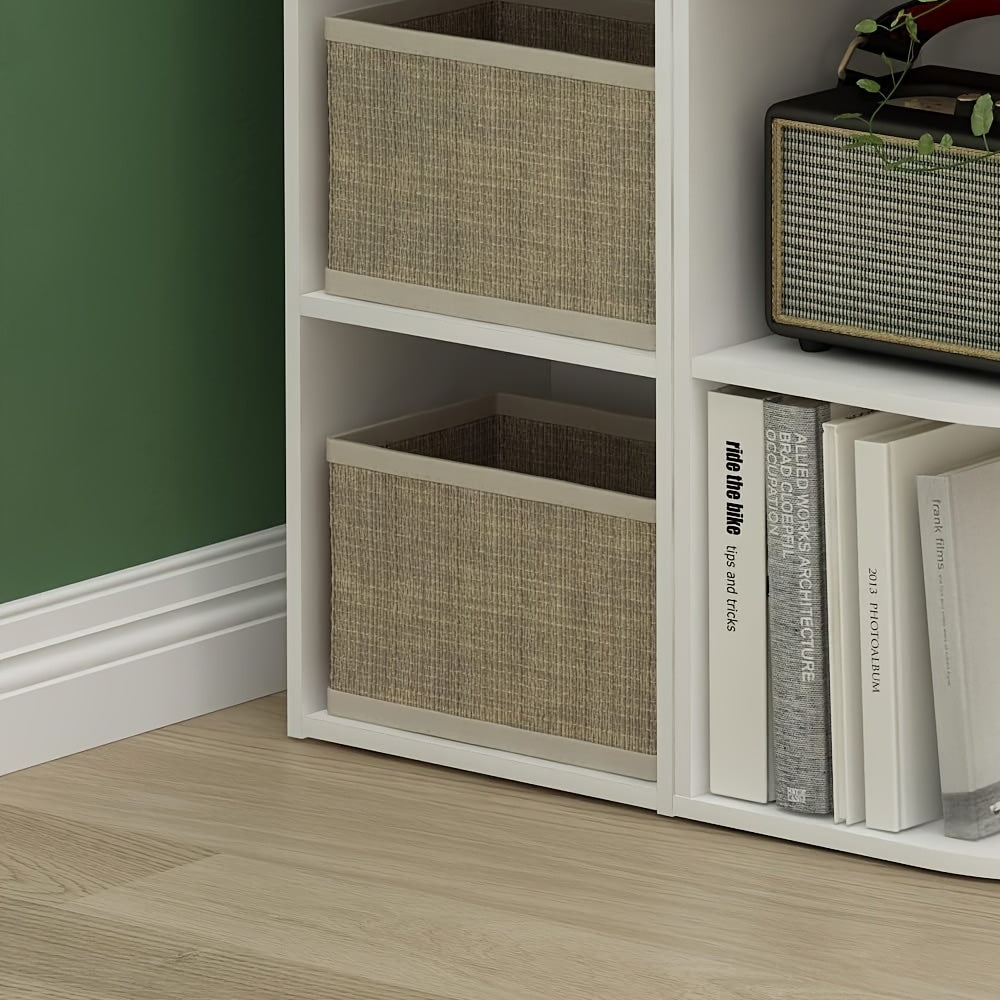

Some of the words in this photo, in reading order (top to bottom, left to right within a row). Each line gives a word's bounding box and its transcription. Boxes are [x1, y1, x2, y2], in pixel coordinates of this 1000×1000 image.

[725, 441, 743, 472] ride
[779, 431, 792, 480] BRAD
[795, 432, 809, 490] ALLIED
[726, 474, 743, 500] the
[766, 429, 779, 539] OCCUPATION
[726, 502, 744, 536] bike
[797, 495, 811, 552] WORKS
[932, 499, 943, 533] frank
[724, 545, 737, 568] tips
[936, 537, 945, 570] films
[726, 571, 738, 595] and
[868, 567, 878, 594] 2013
[726, 598, 740, 632] tricks
[798, 555, 815, 682] ARCHITECTURE
[869, 602, 880, 693] PHOTOALBUM
